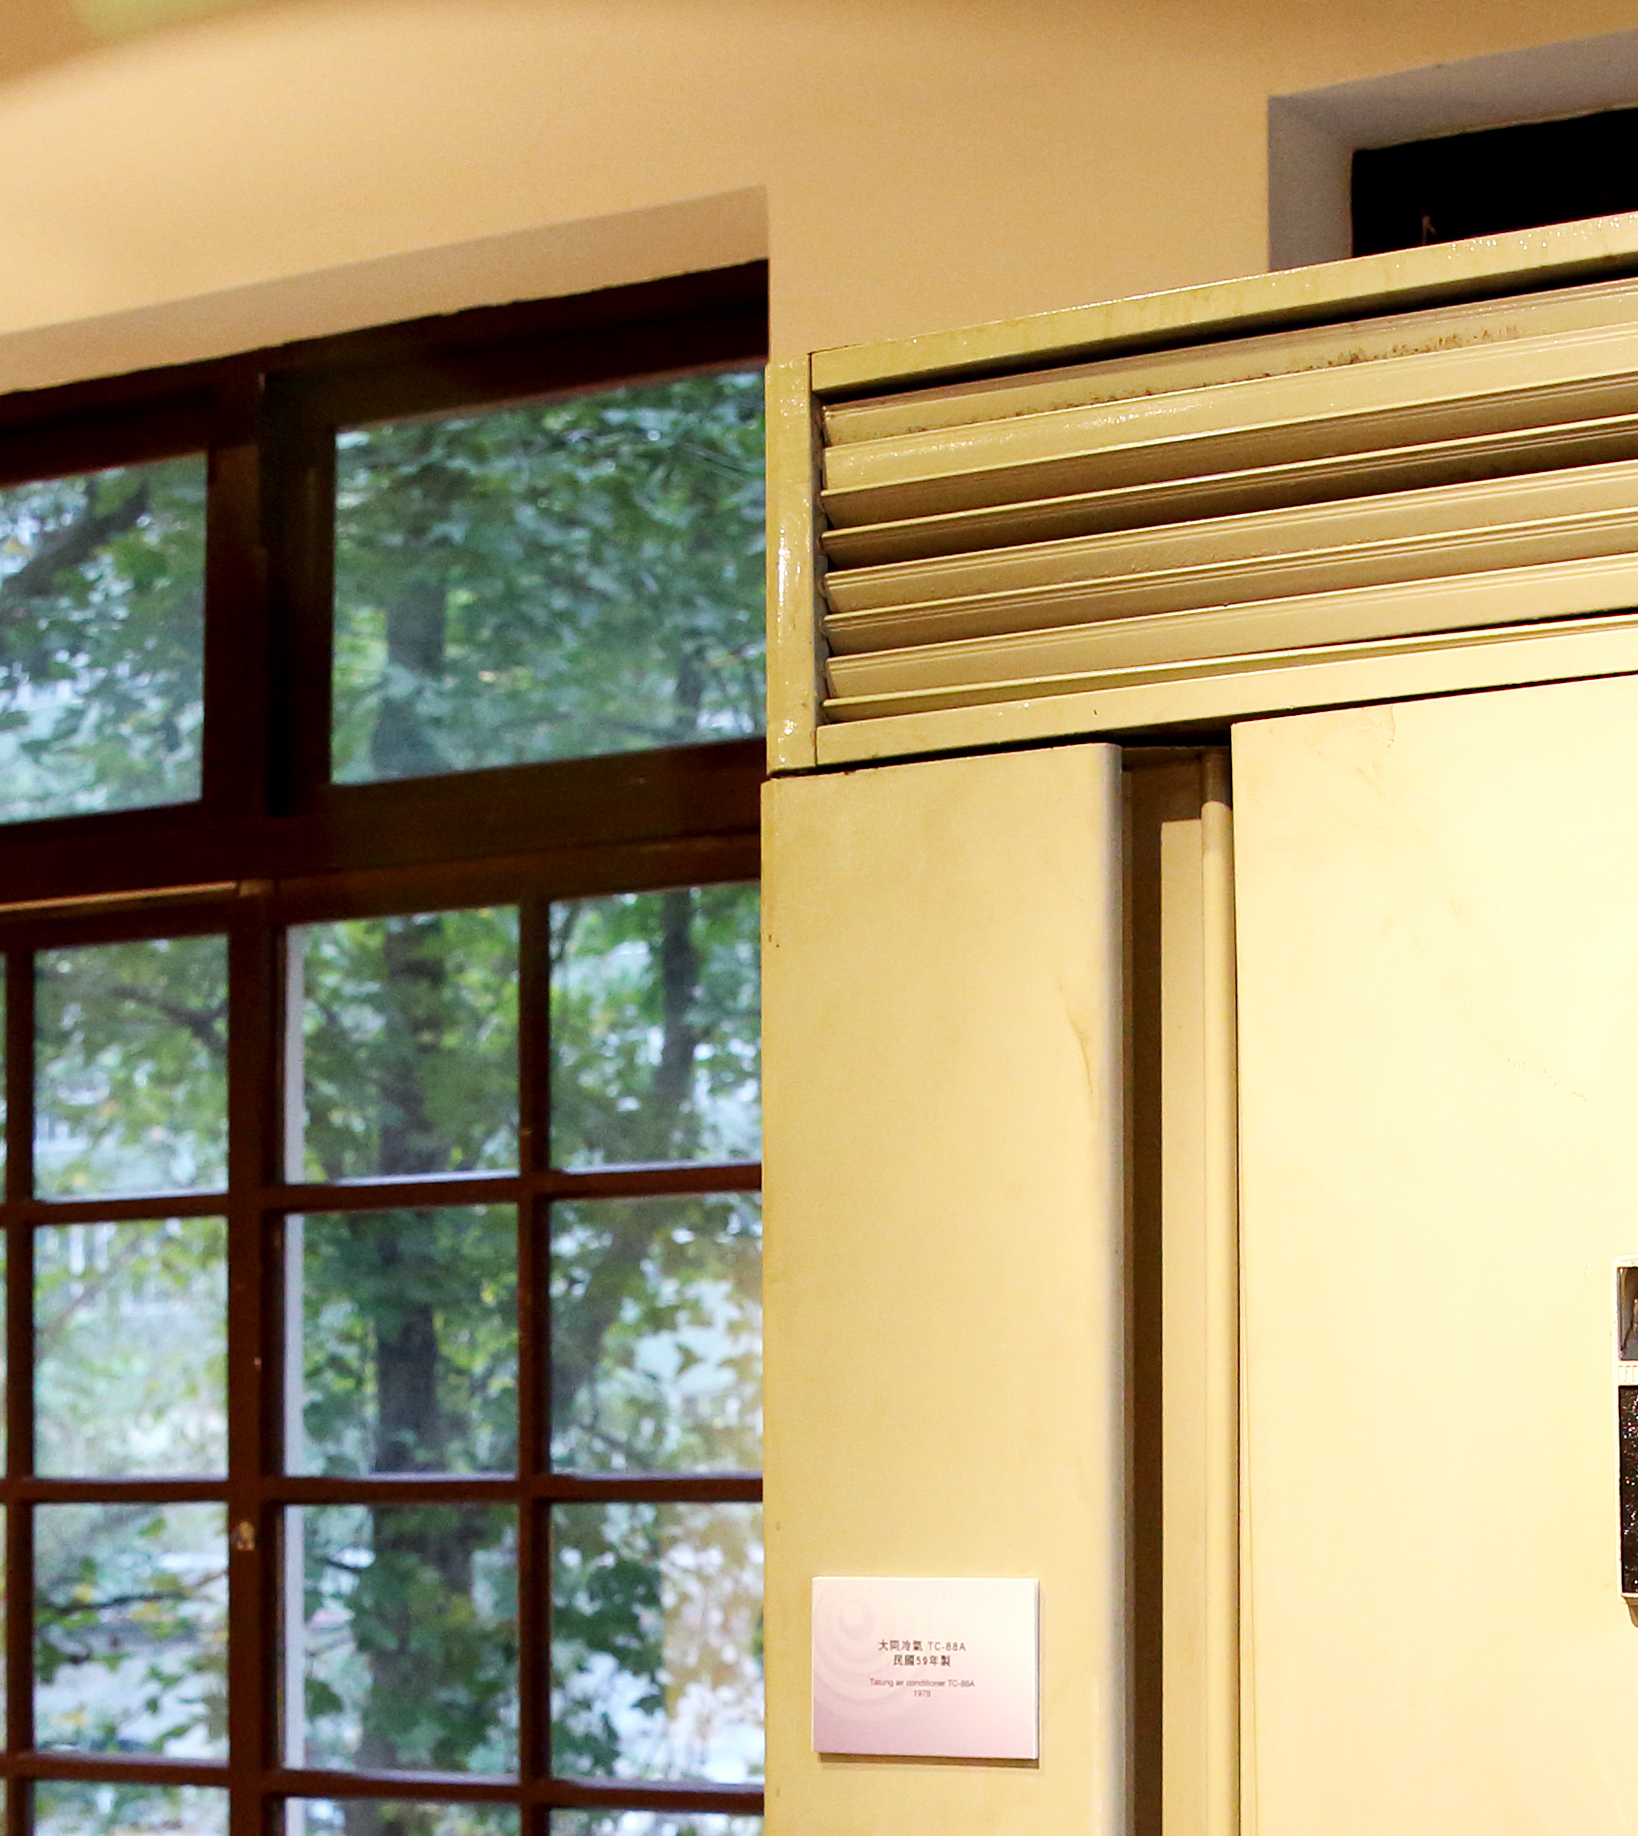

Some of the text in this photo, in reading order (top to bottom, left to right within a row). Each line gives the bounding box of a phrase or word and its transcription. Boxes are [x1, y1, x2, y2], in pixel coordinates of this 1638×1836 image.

[878, 1639, 967, 1651] 大同冷氣 TC-88A
[893, 1654, 951, 1667] 民國59年製
